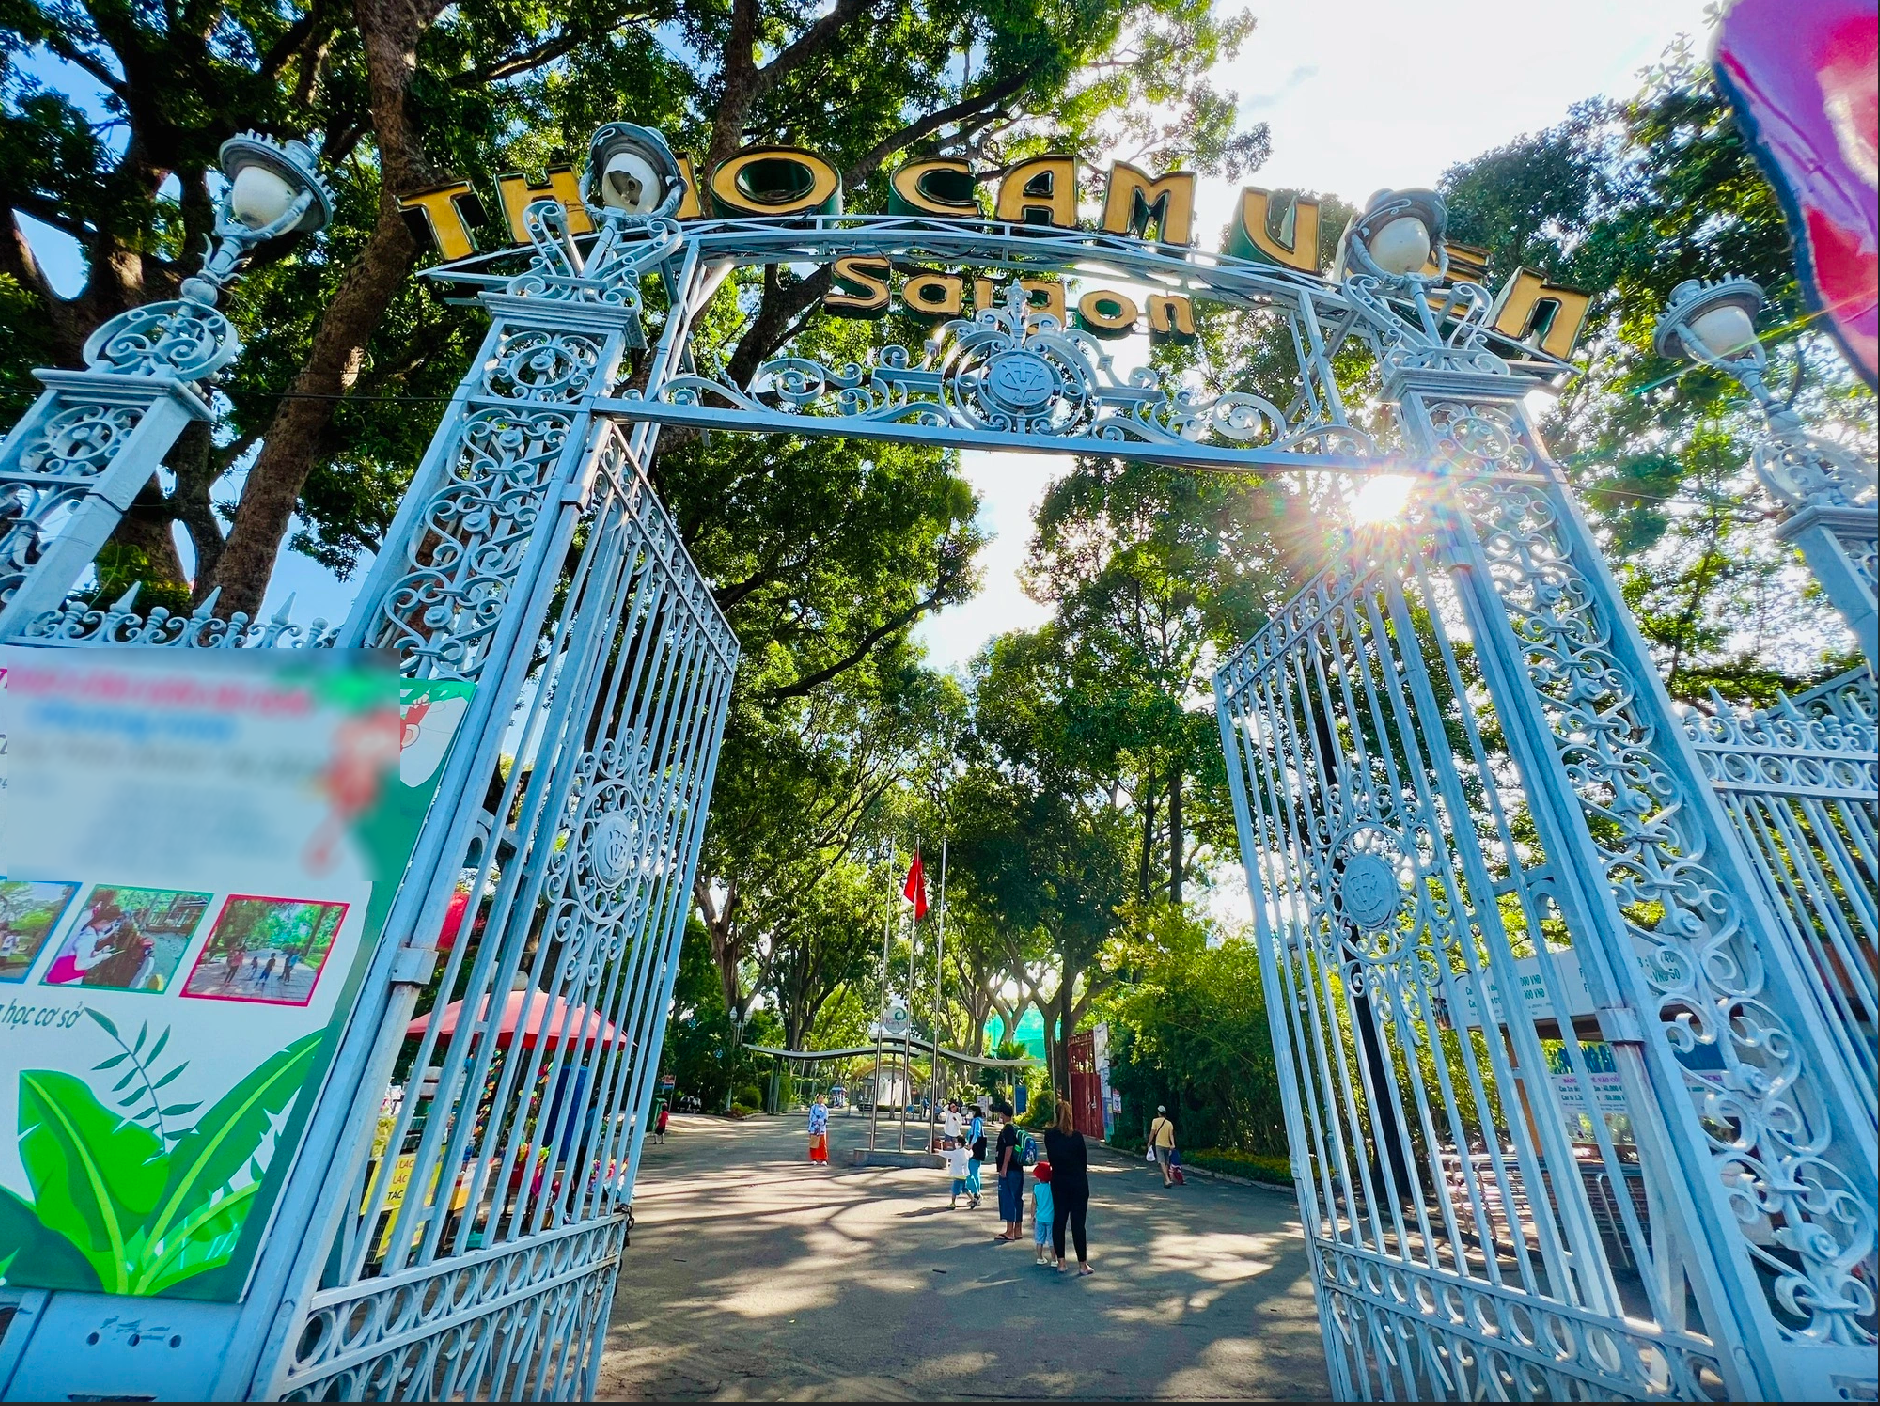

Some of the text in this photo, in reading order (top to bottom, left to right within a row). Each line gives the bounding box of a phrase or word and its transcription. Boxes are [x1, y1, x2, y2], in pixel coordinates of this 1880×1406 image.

[398, 144, 842, 261] THO
[1, 998, 85, 1030] học cơ sở
